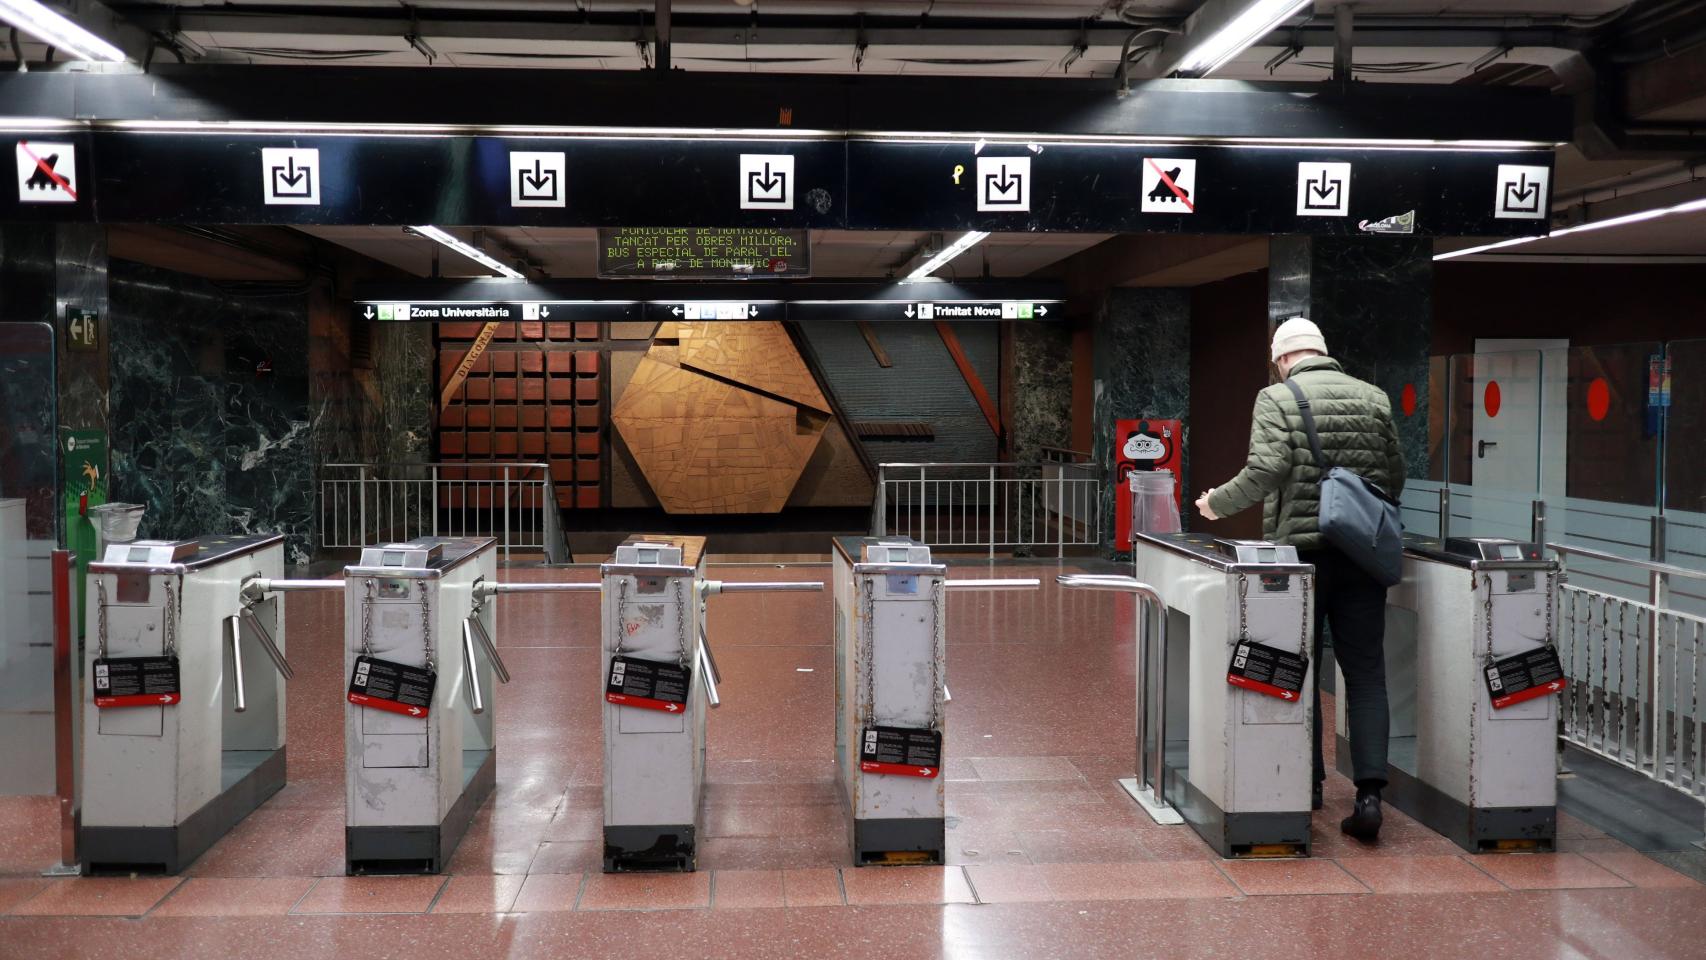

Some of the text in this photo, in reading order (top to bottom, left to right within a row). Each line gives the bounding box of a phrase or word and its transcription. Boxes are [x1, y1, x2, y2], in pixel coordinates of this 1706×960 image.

[614, 236, 798, 247] TANCAT PER OBRES MILLORA.
[607, 247, 630, 258] BUS
[636, 247, 696, 257] ESPECIAL
[703, 247, 718, 257] DE
[637, 259, 645, 269] A
[689, 258, 704, 268] DE
[411, 307, 440, 318] Zona
[442, 306, 510, 318] Universitària
[934, 306, 972, 317] Trinitat
[974, 306, 1001, 317] Nova
